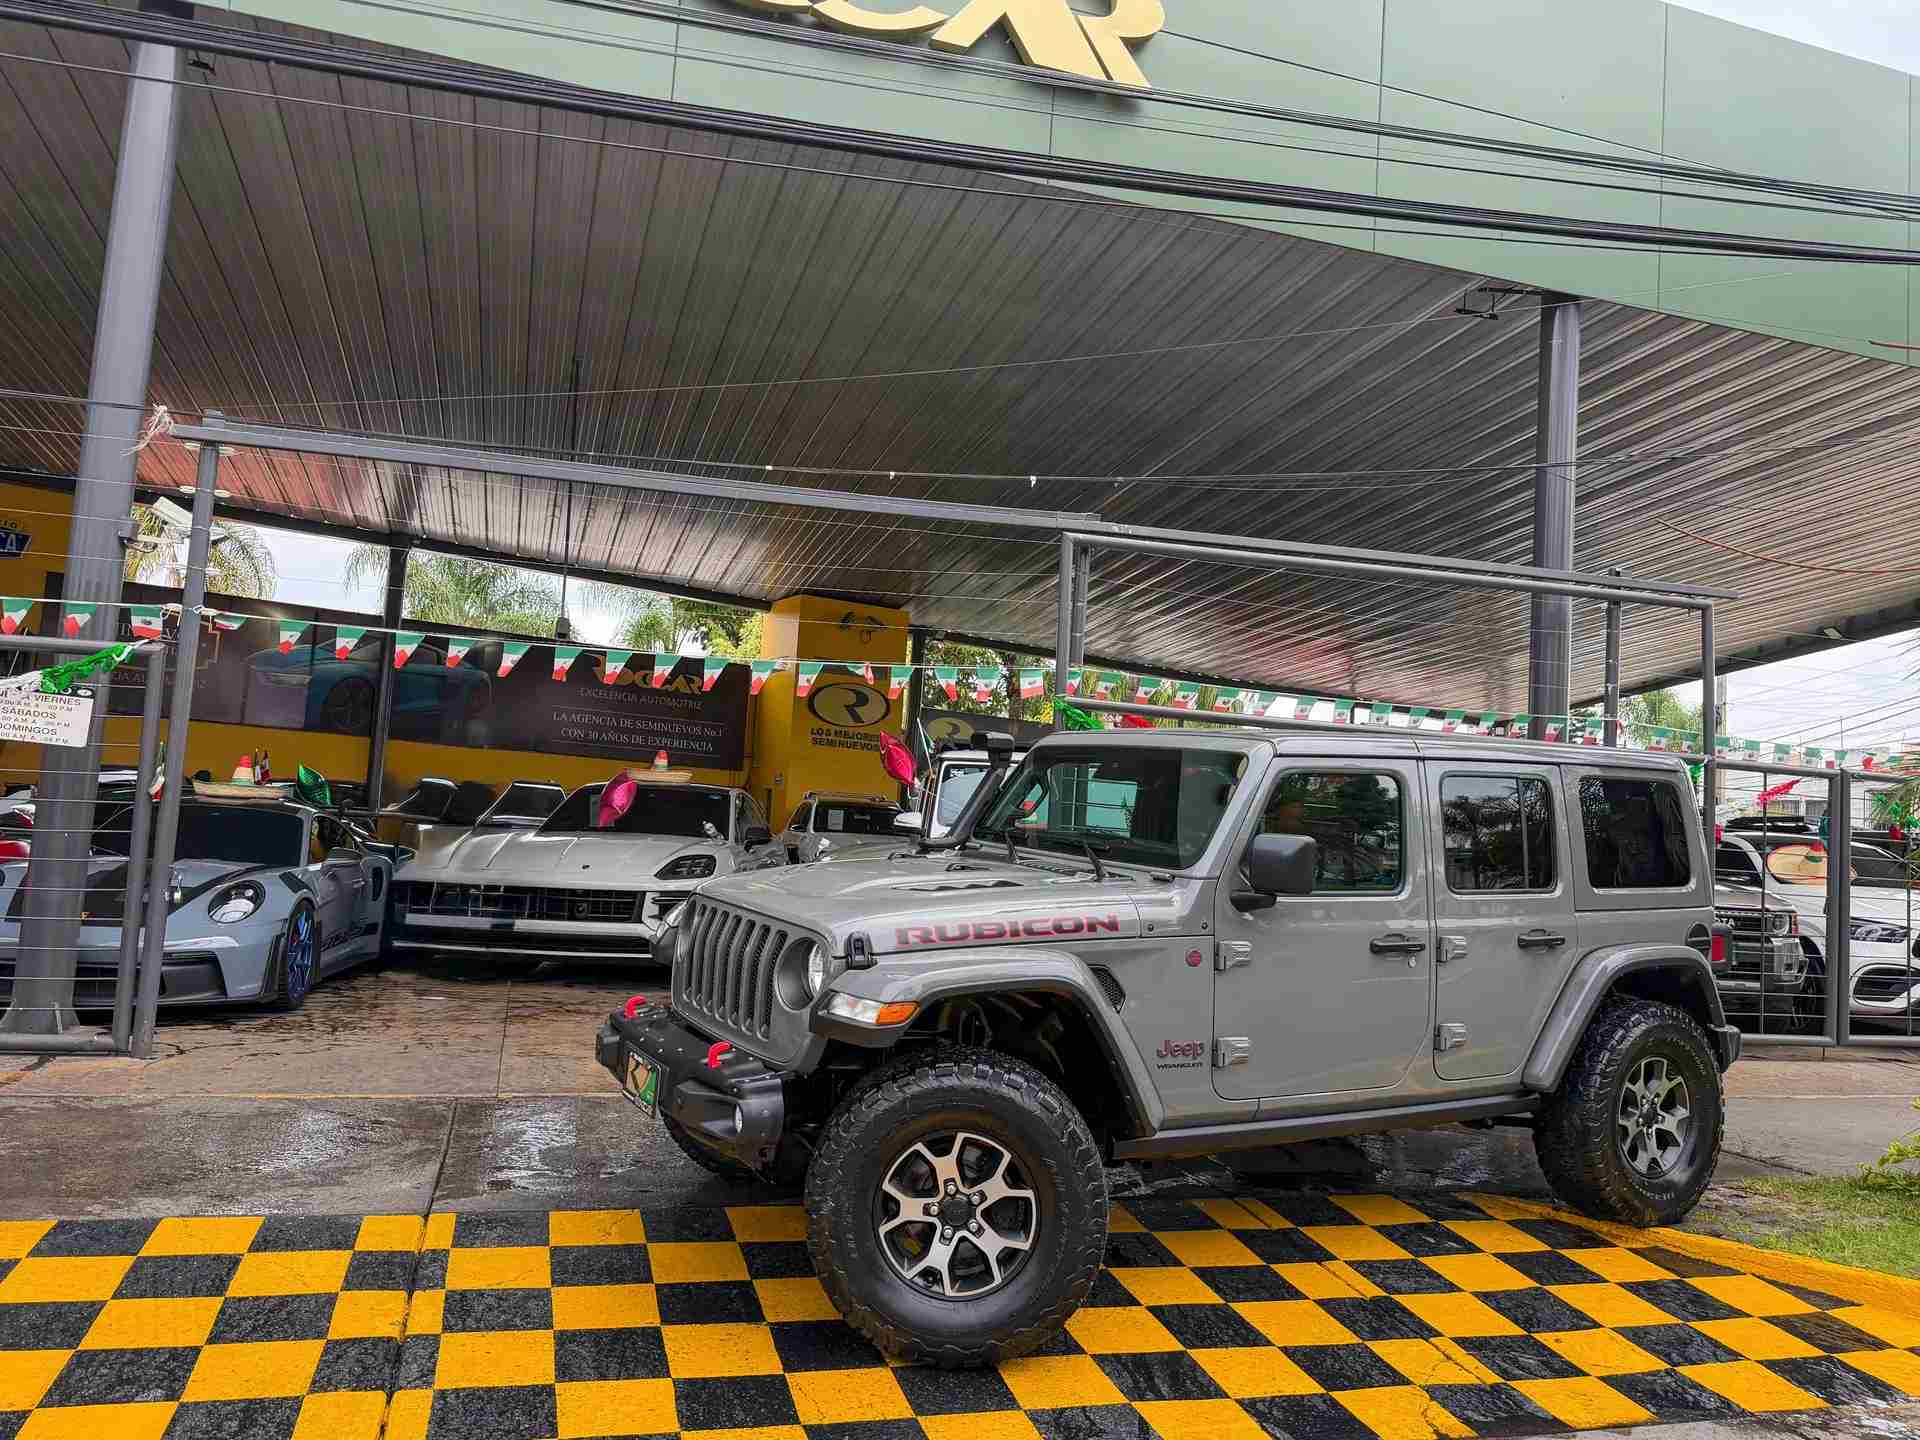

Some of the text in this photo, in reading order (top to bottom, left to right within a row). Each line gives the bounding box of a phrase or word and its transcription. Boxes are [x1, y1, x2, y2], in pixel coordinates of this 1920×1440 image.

[35, 694, 81, 706] VIERNES
[553, 711, 568, 721] LA
[568, 712, 618, 728] AGENCIA
[620, 719, 635, 729] DE
[637, 719, 702, 737] SEMINUEVOS
[810, 727, 831, 737] LOS
[561, 727, 585, 738] CON
[599, 730, 630, 744] AÑOS
[631, 735, 646, 745] DE
[648, 736, 713, 752] EXPERIENCIA
[895, 912, 1121, 948] RUBICON
[1156, 1039, 1204, 1061] Jeep
